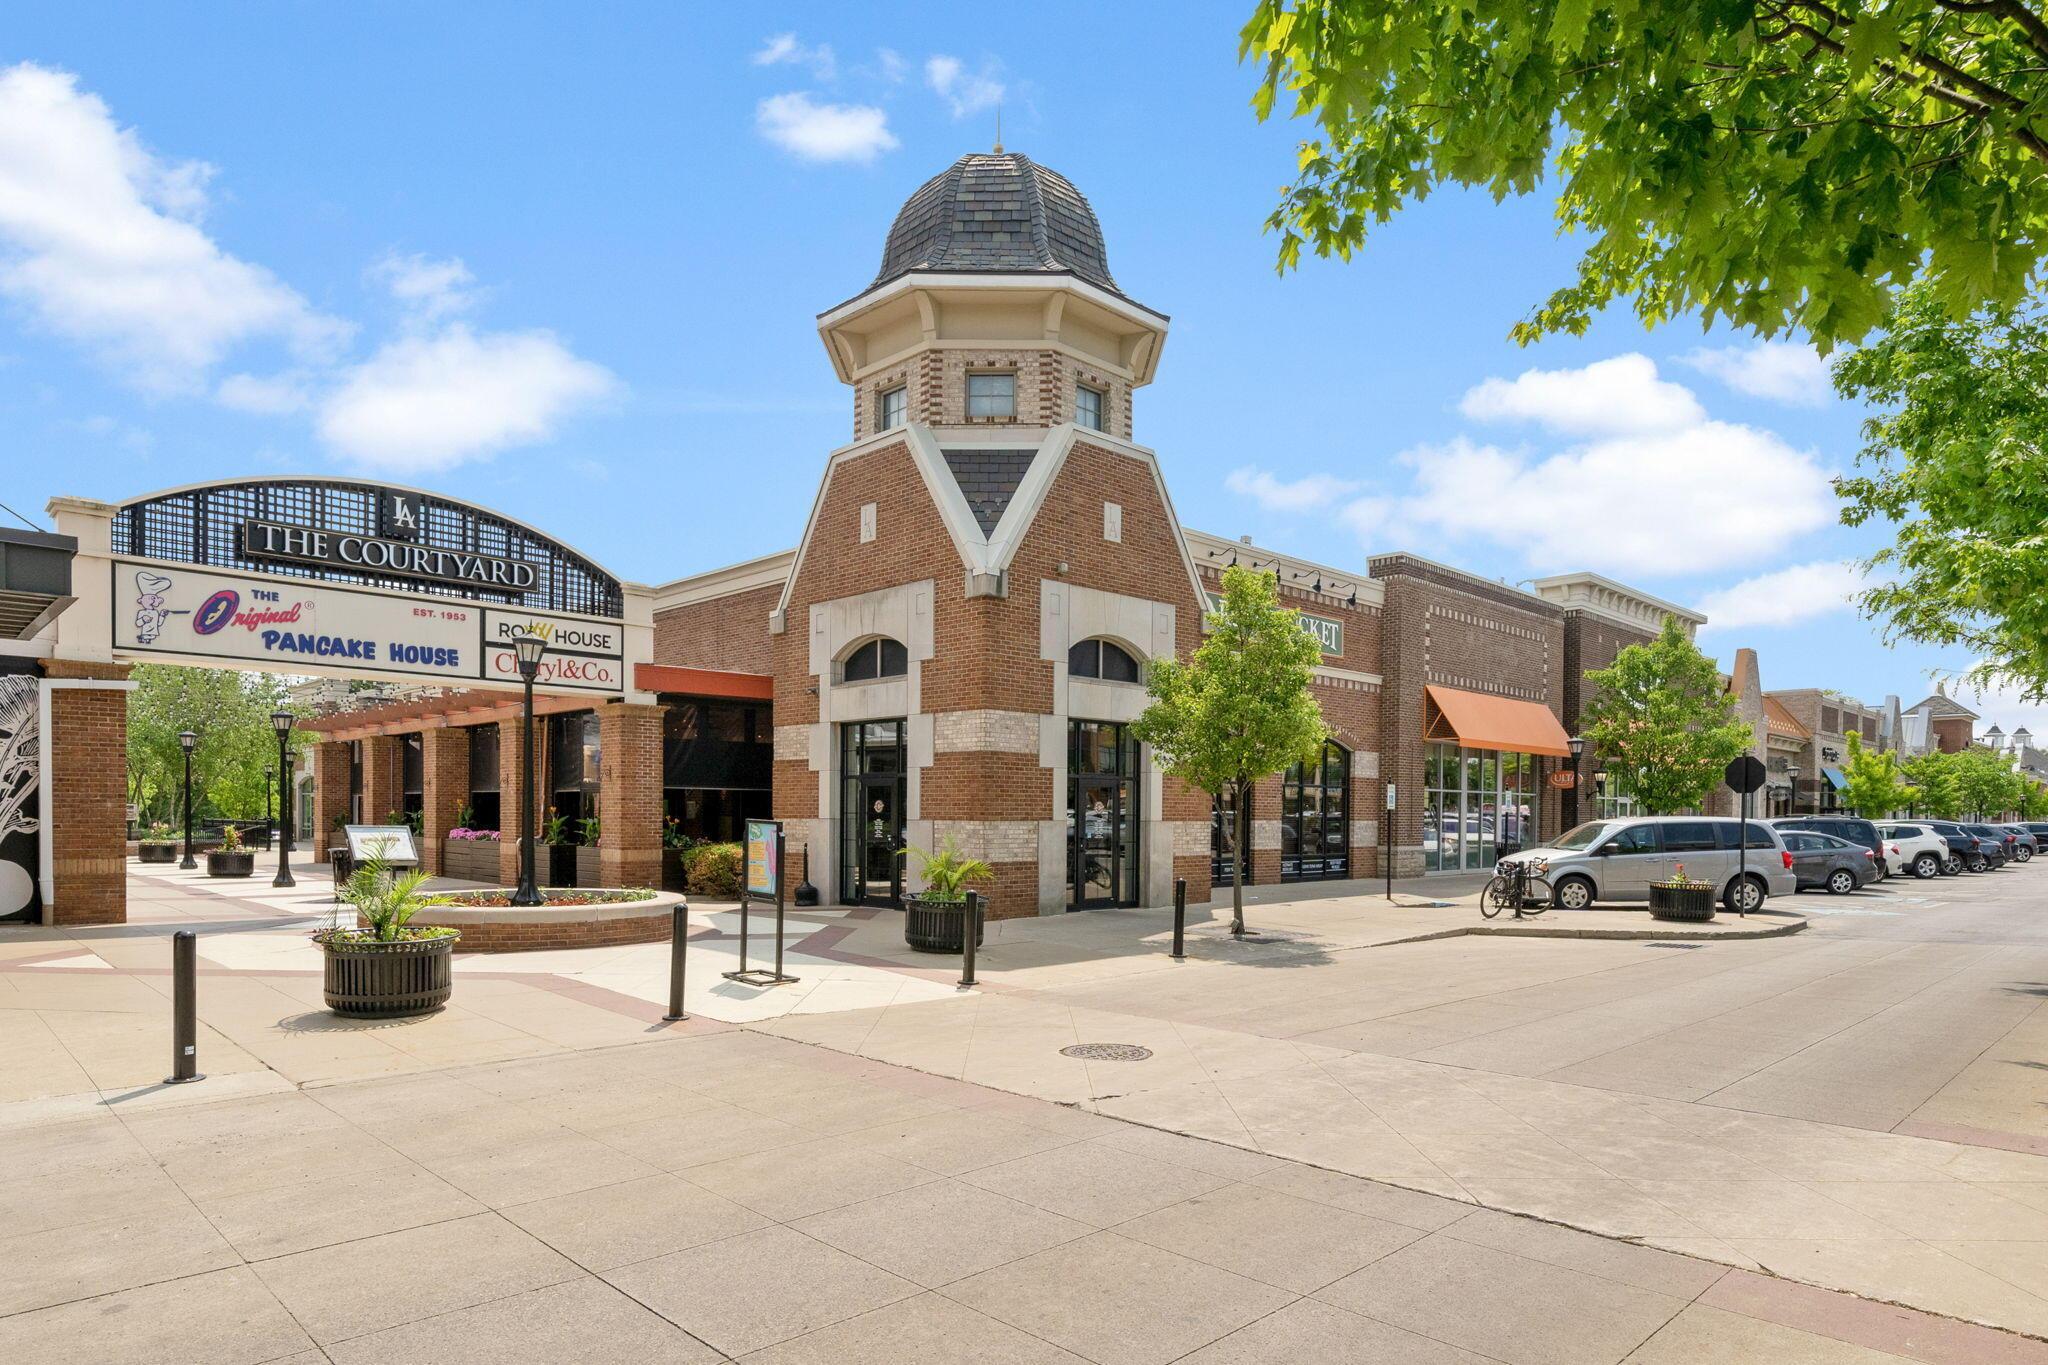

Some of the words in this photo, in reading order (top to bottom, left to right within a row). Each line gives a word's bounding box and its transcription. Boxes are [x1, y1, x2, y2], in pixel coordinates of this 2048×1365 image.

[393, 496, 417, 529] LA
[257, 523, 329, 559] THE
[339, 536, 534, 587] COURTYARD
[251, 589, 280, 602] THE
[413, 608, 437, 620] EST.
[440, 611, 467, 622] 1953
[261, 630, 376, 661] PANCAKE
[389, 643, 460, 668] HOUSE
[555, 629, 612, 649] HOUSE
